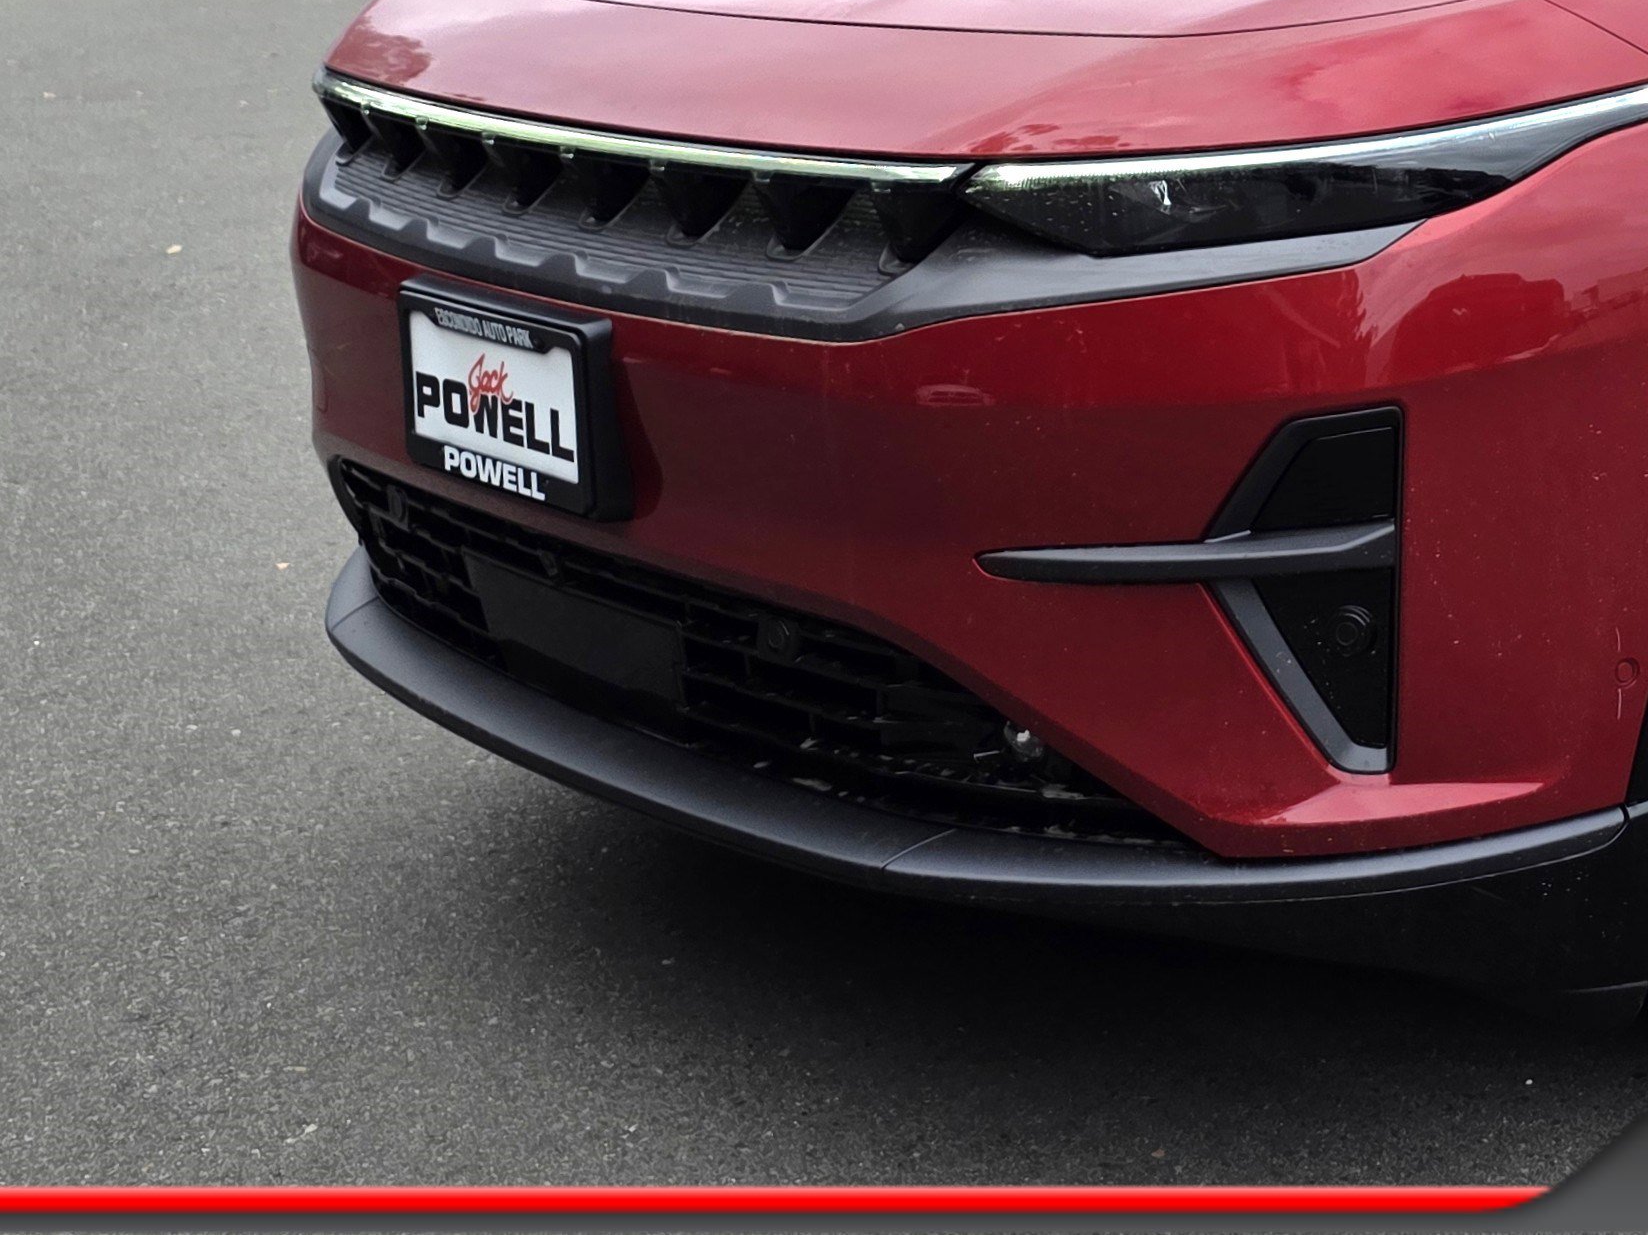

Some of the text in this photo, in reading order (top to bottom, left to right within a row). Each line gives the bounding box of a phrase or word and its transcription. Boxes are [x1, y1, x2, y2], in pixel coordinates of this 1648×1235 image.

[434, 308, 534, 349] ESCONDIDO AUTO PARK
[468, 353, 513, 415] Jack
[415, 371, 575, 463] POWELL
[443, 445, 546, 502] POWELL
